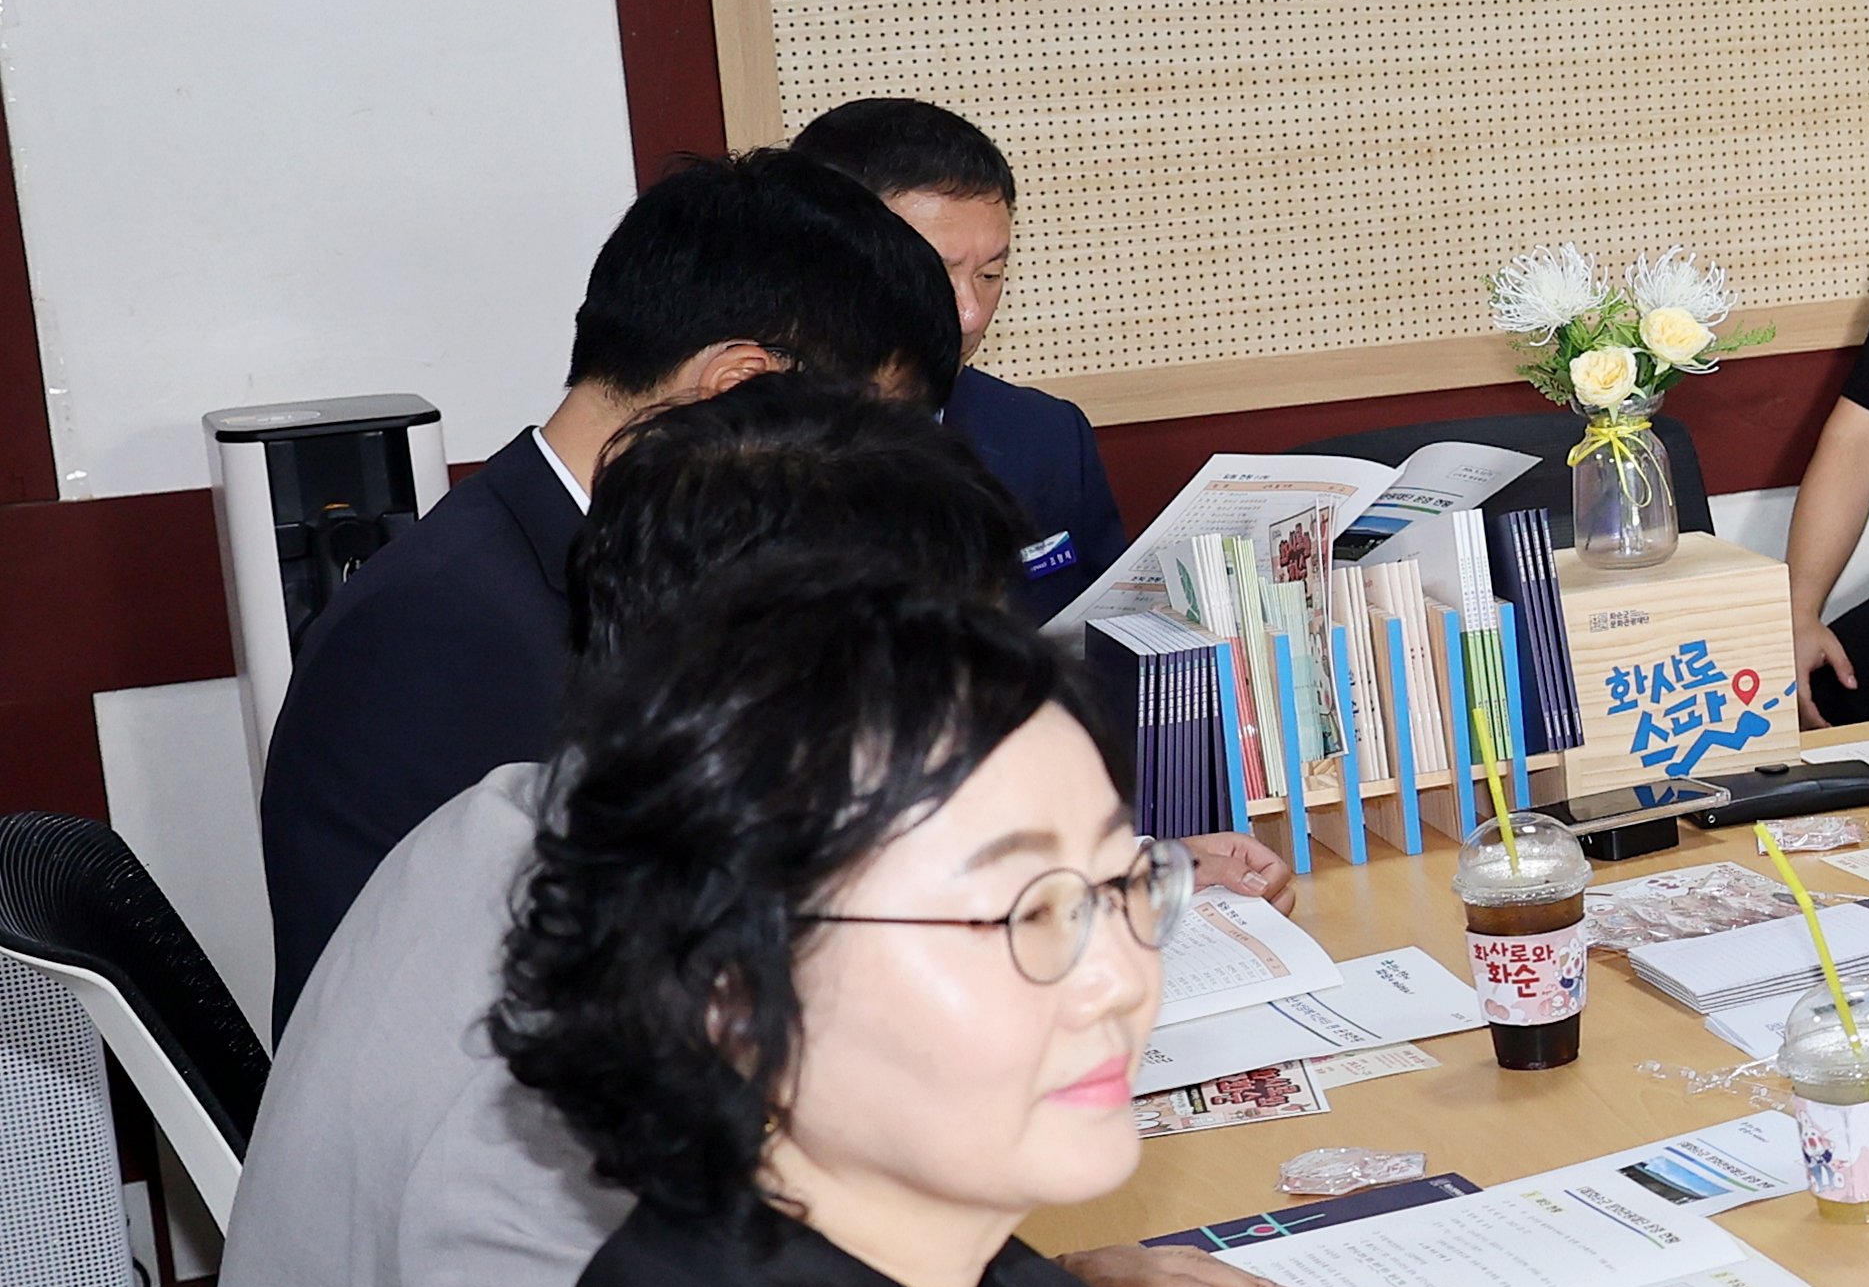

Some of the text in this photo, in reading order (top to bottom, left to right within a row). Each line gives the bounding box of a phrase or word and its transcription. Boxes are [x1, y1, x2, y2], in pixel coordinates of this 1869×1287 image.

[1605, 639, 1729, 716] 화사로
[1474, 942, 1557, 965] 화사로와,
[1487, 963, 1541, 998] 화순
